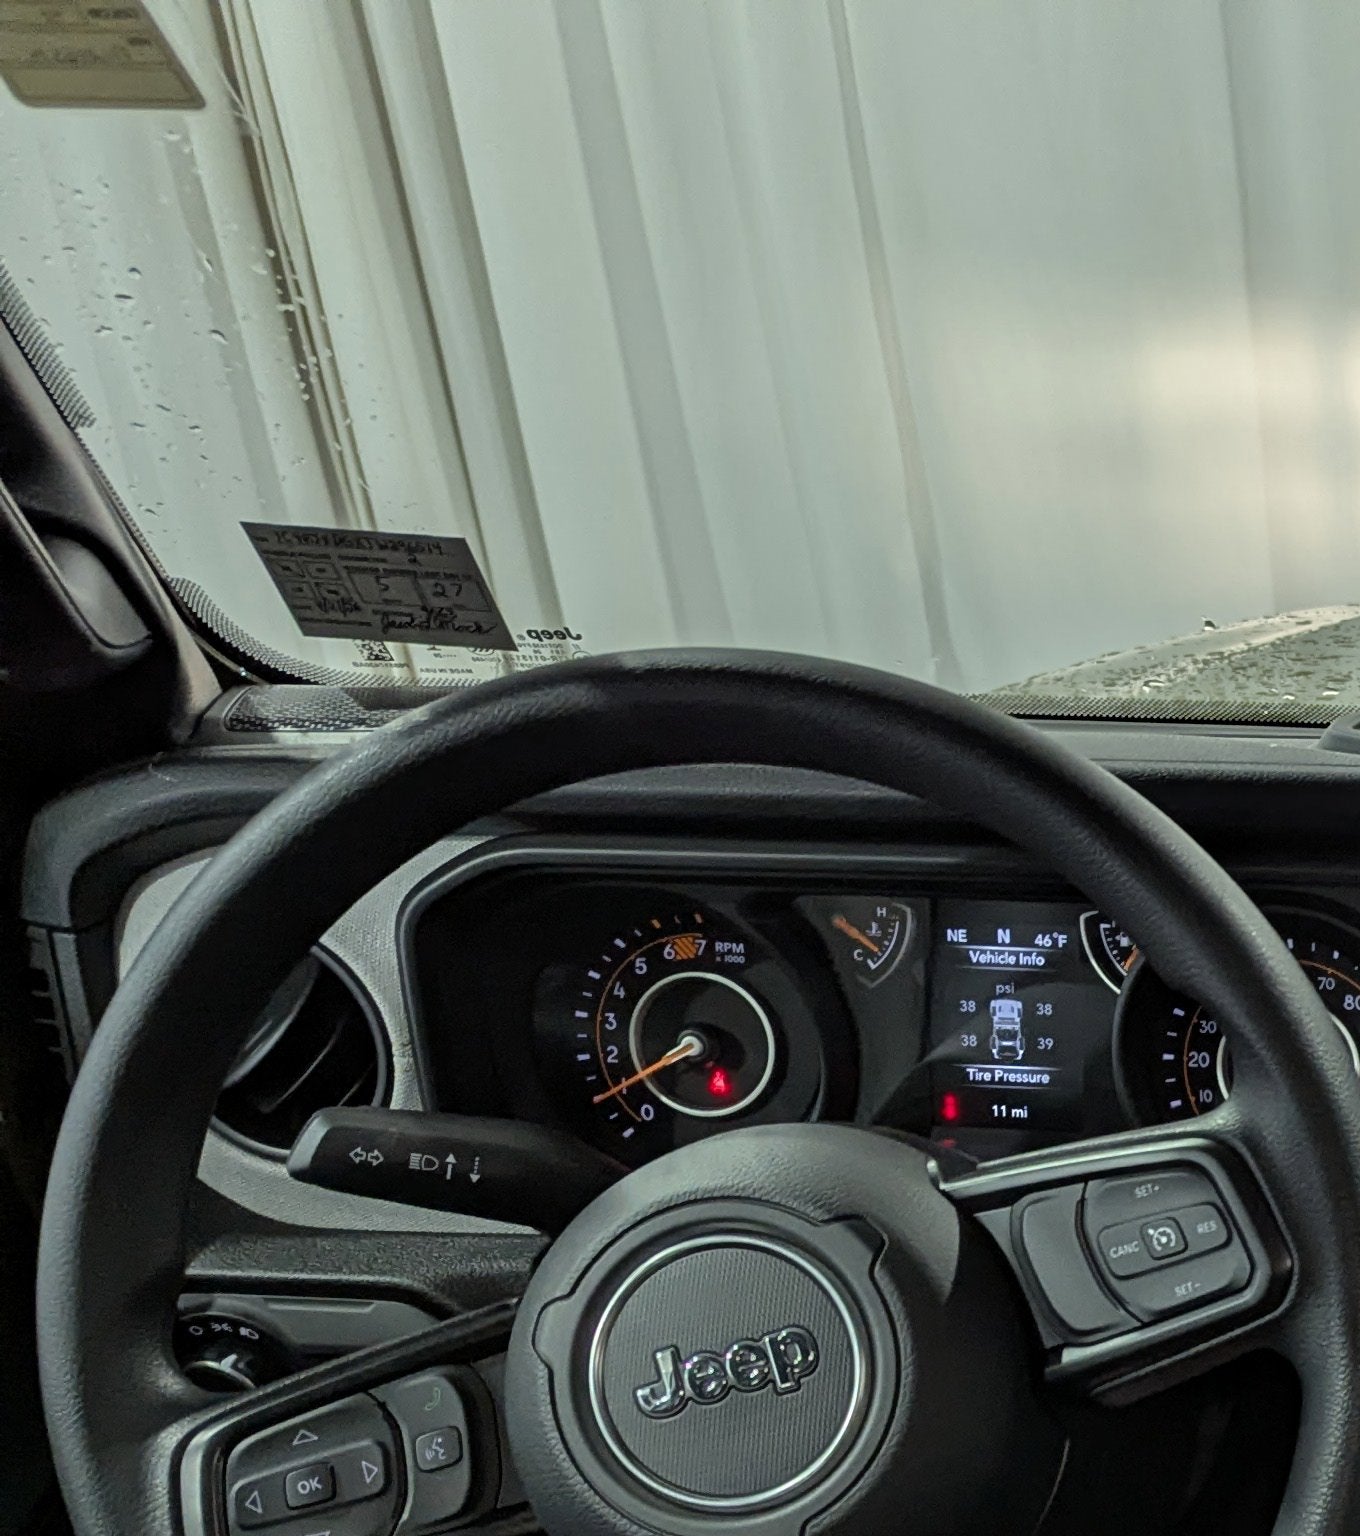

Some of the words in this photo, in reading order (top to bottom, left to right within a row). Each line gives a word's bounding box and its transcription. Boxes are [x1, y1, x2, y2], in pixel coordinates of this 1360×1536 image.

[876, 906, 887, 918] H
[946, 928, 968, 943] NE
[997, 928, 1011, 944] N
[1034, 931, 1068, 948] 46°F
[663, 943, 676, 960] 6
[695, 939, 707, 956] 7
[715, 941, 745, 955] RPM
[853, 948, 864, 961] C
[634, 957, 648, 975] 5
[968, 950, 1017, 965] Vehicle
[1019, 952, 1046, 967] Info
[613, 981, 626, 999] 4
[995, 981, 1016, 996] psi
[1317, 977, 1336, 991] 70
[959, 1000, 976, 1014] 38
[1036, 1003, 1053, 1017] 38
[604, 1012, 618, 1030] 3
[1199, 1020, 1218, 1035] 30
[960, 1035, 978, 1048] 38
[1036, 1037, 1054, 1051] 39
[606, 1045, 619, 1063] 2
[1188, 1052, 1211, 1068] 20
[966, 1067, 992, 1082] Tire
[994, 1070, 1050, 1085] Pressure
[1199, 1089, 1214, 1103] 10
[640, 1104, 655, 1121] 0
[991, 1105, 1007, 1118] 11
[1011, 1105, 1029, 1119] mi
[1196, 1219, 1218, 1235] RES
[1108, 1240, 1141, 1259] CANC
[632, 1324, 822, 1420] Jeep
[296, 1475, 323, 1496] OK
